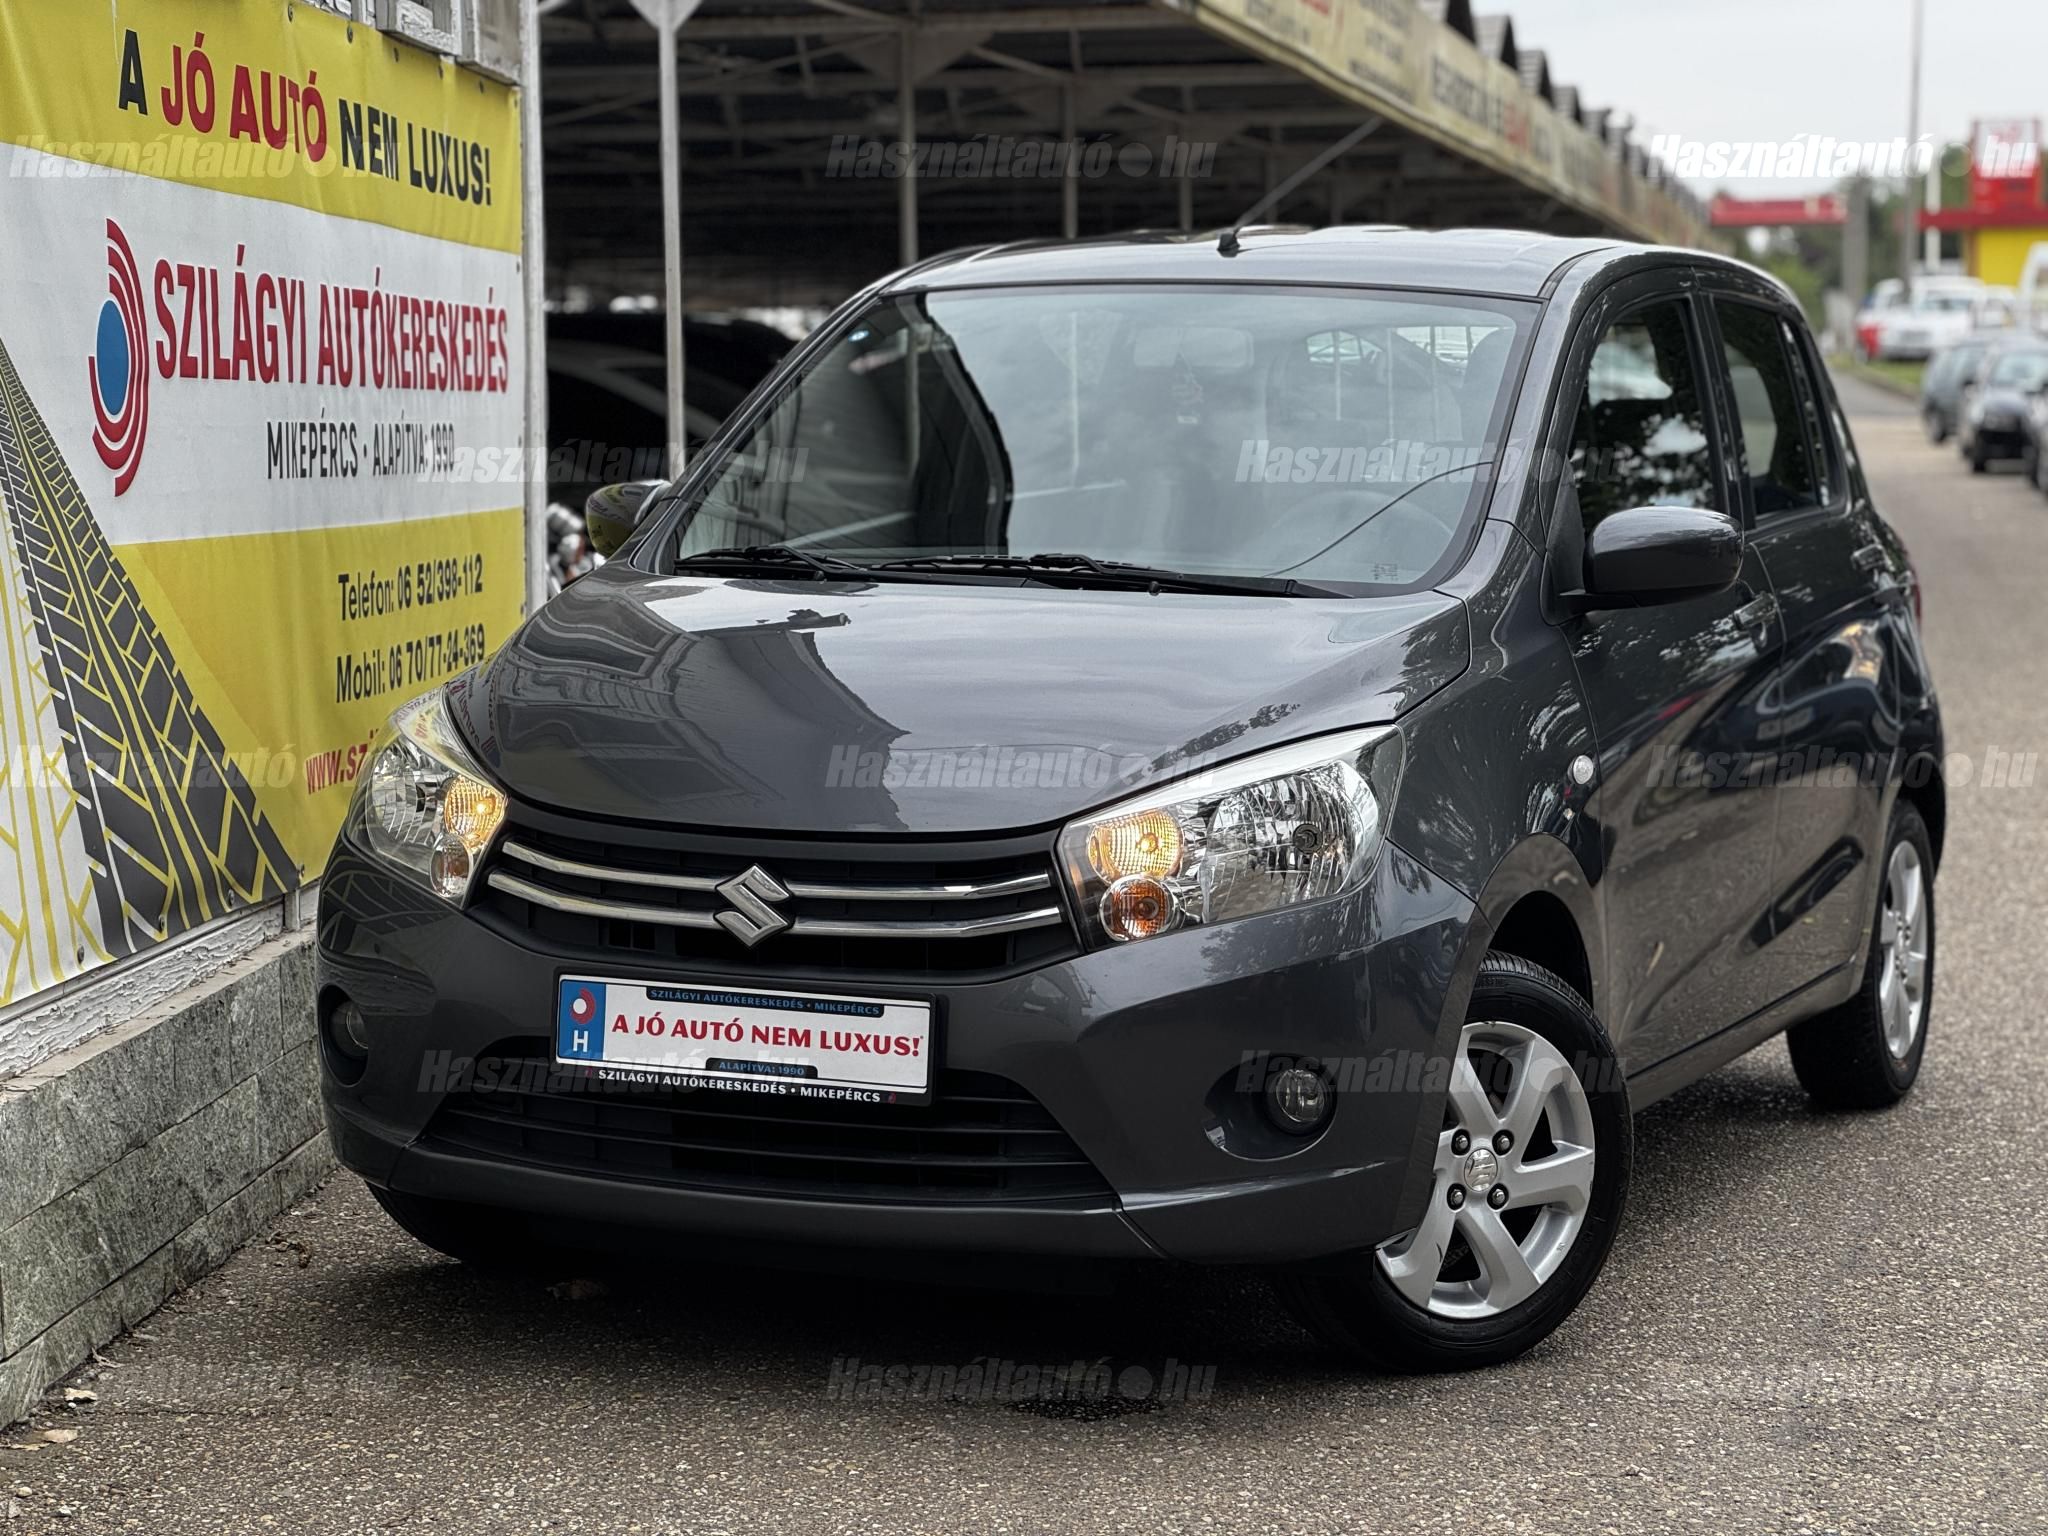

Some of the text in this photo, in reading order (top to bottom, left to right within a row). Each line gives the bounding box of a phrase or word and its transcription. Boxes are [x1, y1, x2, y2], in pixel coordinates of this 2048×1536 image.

[118, 28, 492, 206] A JÓ AUTÓ NEM LUXUS!
[154, 244, 509, 394] SZILÁGYI AUTÓKERESKEDÉS
[267, 407, 358, 480] MIKEPÉRCS
[338, 553, 483, 621] Telefon: 06 52/398-112
[336, 623, 485, 704] Mobil: 06 70/77-24-369
[650, 989, 880, 1015] SZILÁGYI AUTÓKERESKEDÉS MIKEPÉRCS
[572, 1029, 589, 1053] H
[611, 1012, 920, 1057] A JÓ AUTÓ NEM LUXUS!
[598, 1069, 881, 1103] SZILÁGYI AUTÓKERESKEDÉS MIKEPÉRCS
[719, 1061, 805, 1076] ALAPÍTVA: 1990
